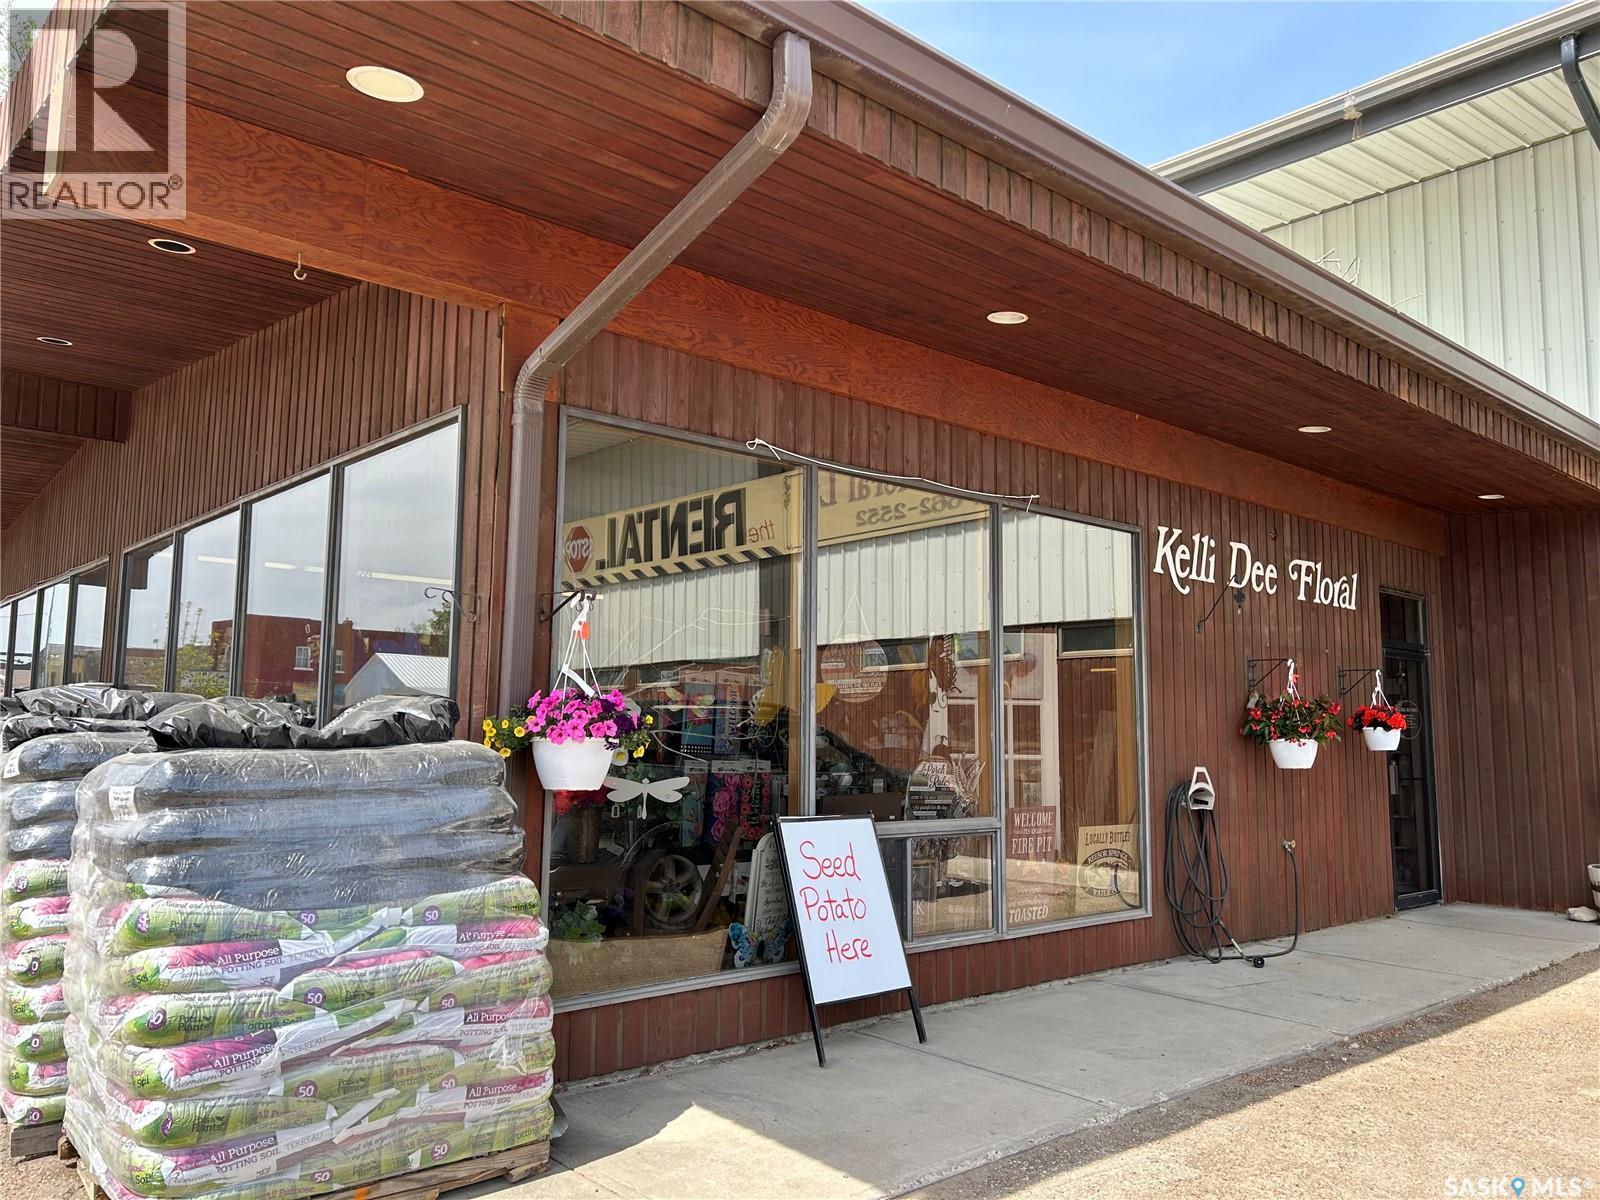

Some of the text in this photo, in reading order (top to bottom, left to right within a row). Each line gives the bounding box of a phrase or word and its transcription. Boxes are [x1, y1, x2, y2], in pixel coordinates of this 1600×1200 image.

[1153, 525, 1358, 611] Kelli Dee Floral
[1014, 811, 1054, 827] WELCOME
[1012, 836, 1053, 854] FIRE PIT
[800, 841, 861, 881] Seed
[799, 887, 867, 921] Potato
[300, 913, 315, 925] 50
[425, 910, 439, 922] 50
[1008, 905, 1049, 923] TOASTED
[826, 929, 872, 963] Here
[218, 946, 280, 966] All Purpose
[221, 960, 263, 975] POTTING
[264, 957, 285, 968] SOIL
[307, 992, 323, 1005] 50
[441, 999, 455, 1010] 50
[466, 1014, 479, 1023] All
[214, 1055, 229, 1069] All
[219, 1058, 262, 1077] POTTING
[297, 1084, 315, 1097] 50
[441, 1078, 456, 1089] 50
[468, 1083, 518, 1098] All Purpose
[463, 1099, 496, 1109] POTTING
[210, 1135, 276, 1164] All Purpose
[432, 1142, 449, 1156] 50
[217, 1155, 258, 1173] POTTING
[259, 1147, 282, 1162] SOIL
[314, 1171, 331, 1183] 50
